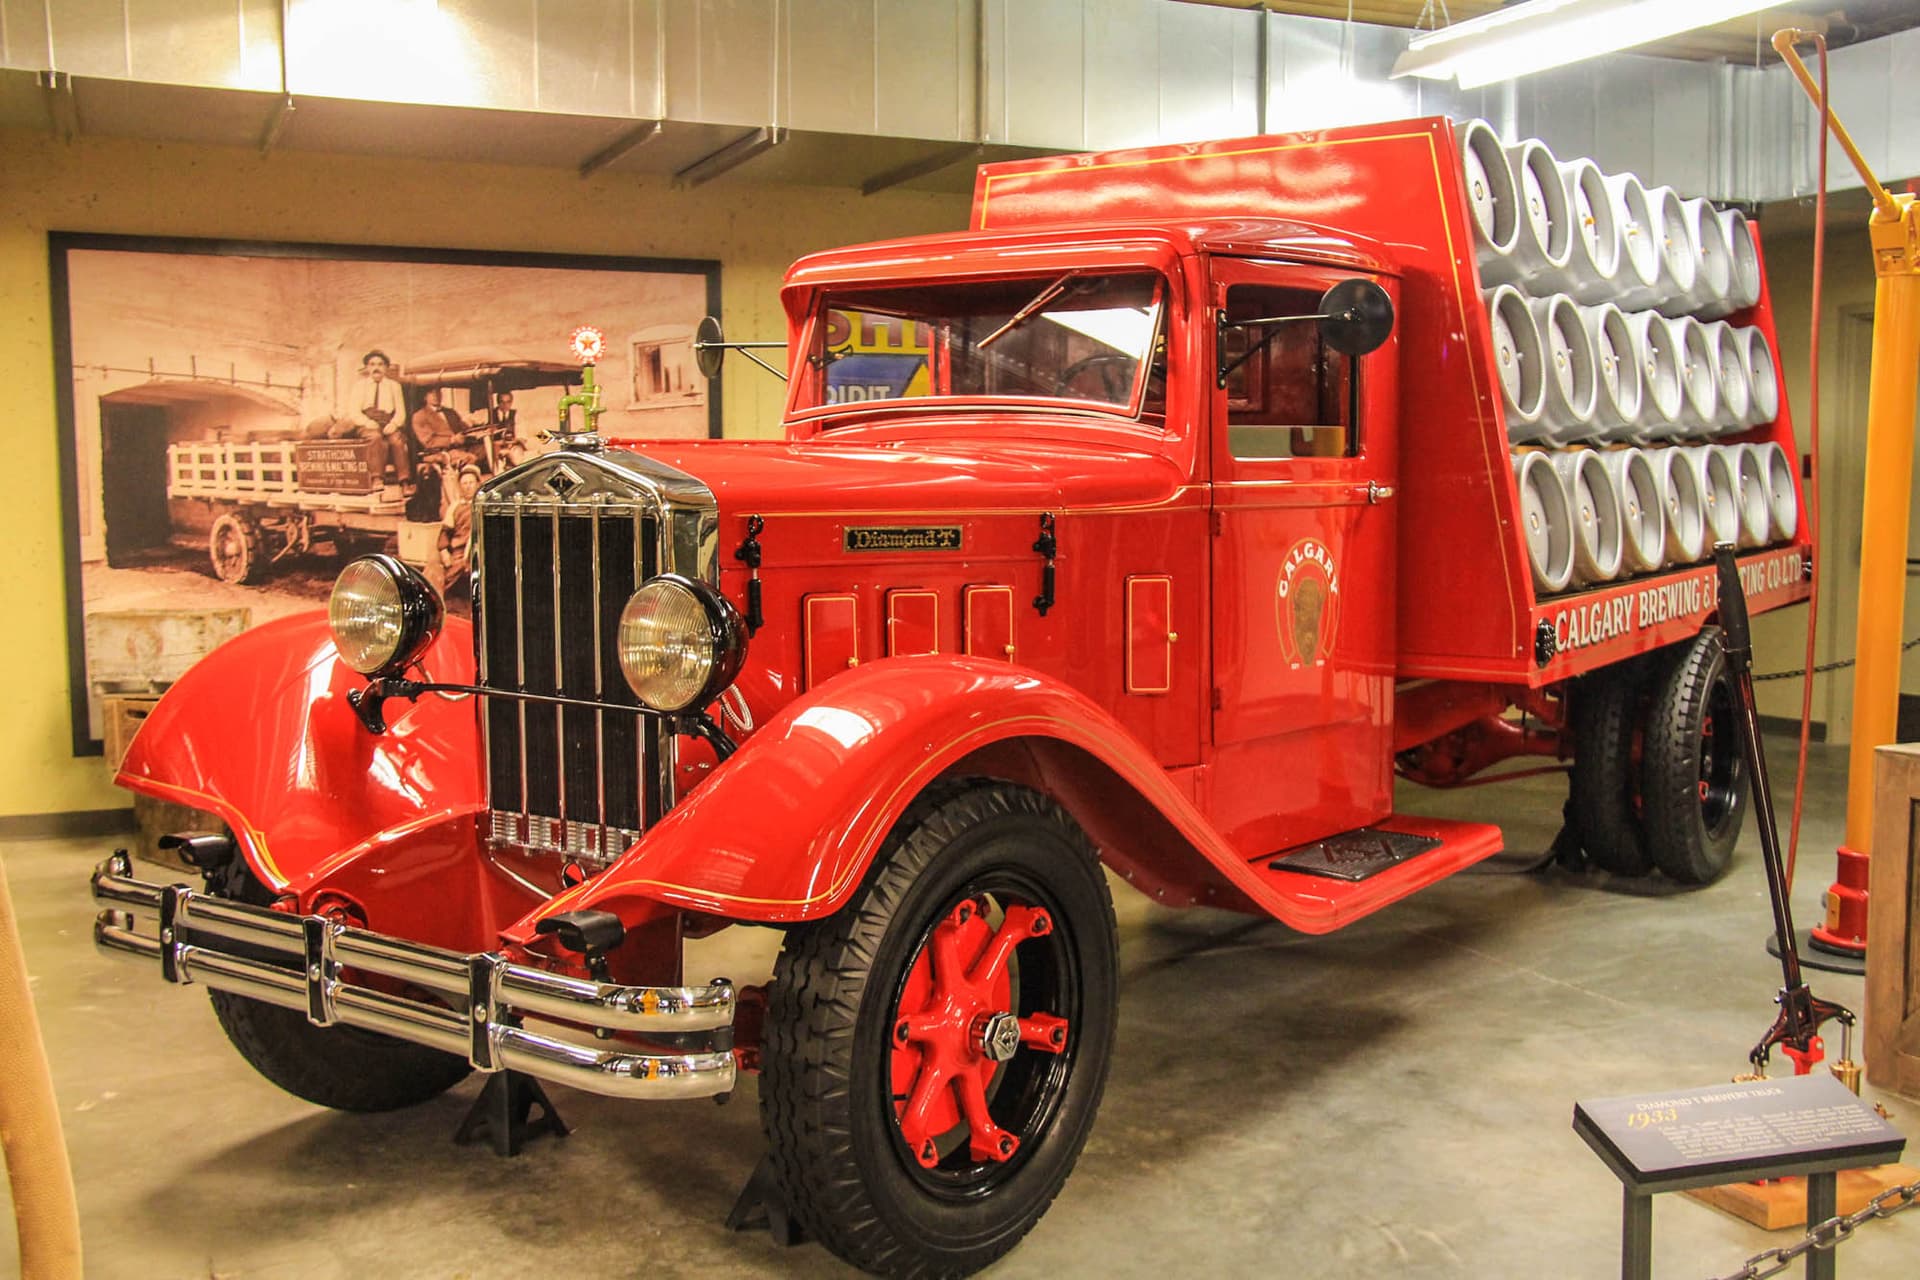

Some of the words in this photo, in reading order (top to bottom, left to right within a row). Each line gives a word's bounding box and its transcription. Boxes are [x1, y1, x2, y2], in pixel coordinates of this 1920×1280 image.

[854, 529, 936, 549] Diamond
[1278, 543, 1339, 598] CALGARY
[1555, 594, 1635, 652] CALGARY
[1638, 577, 1701, 629] BREWING
[1703, 574, 1711, 610] &
[1627, 1107, 1678, 1129] 1933
